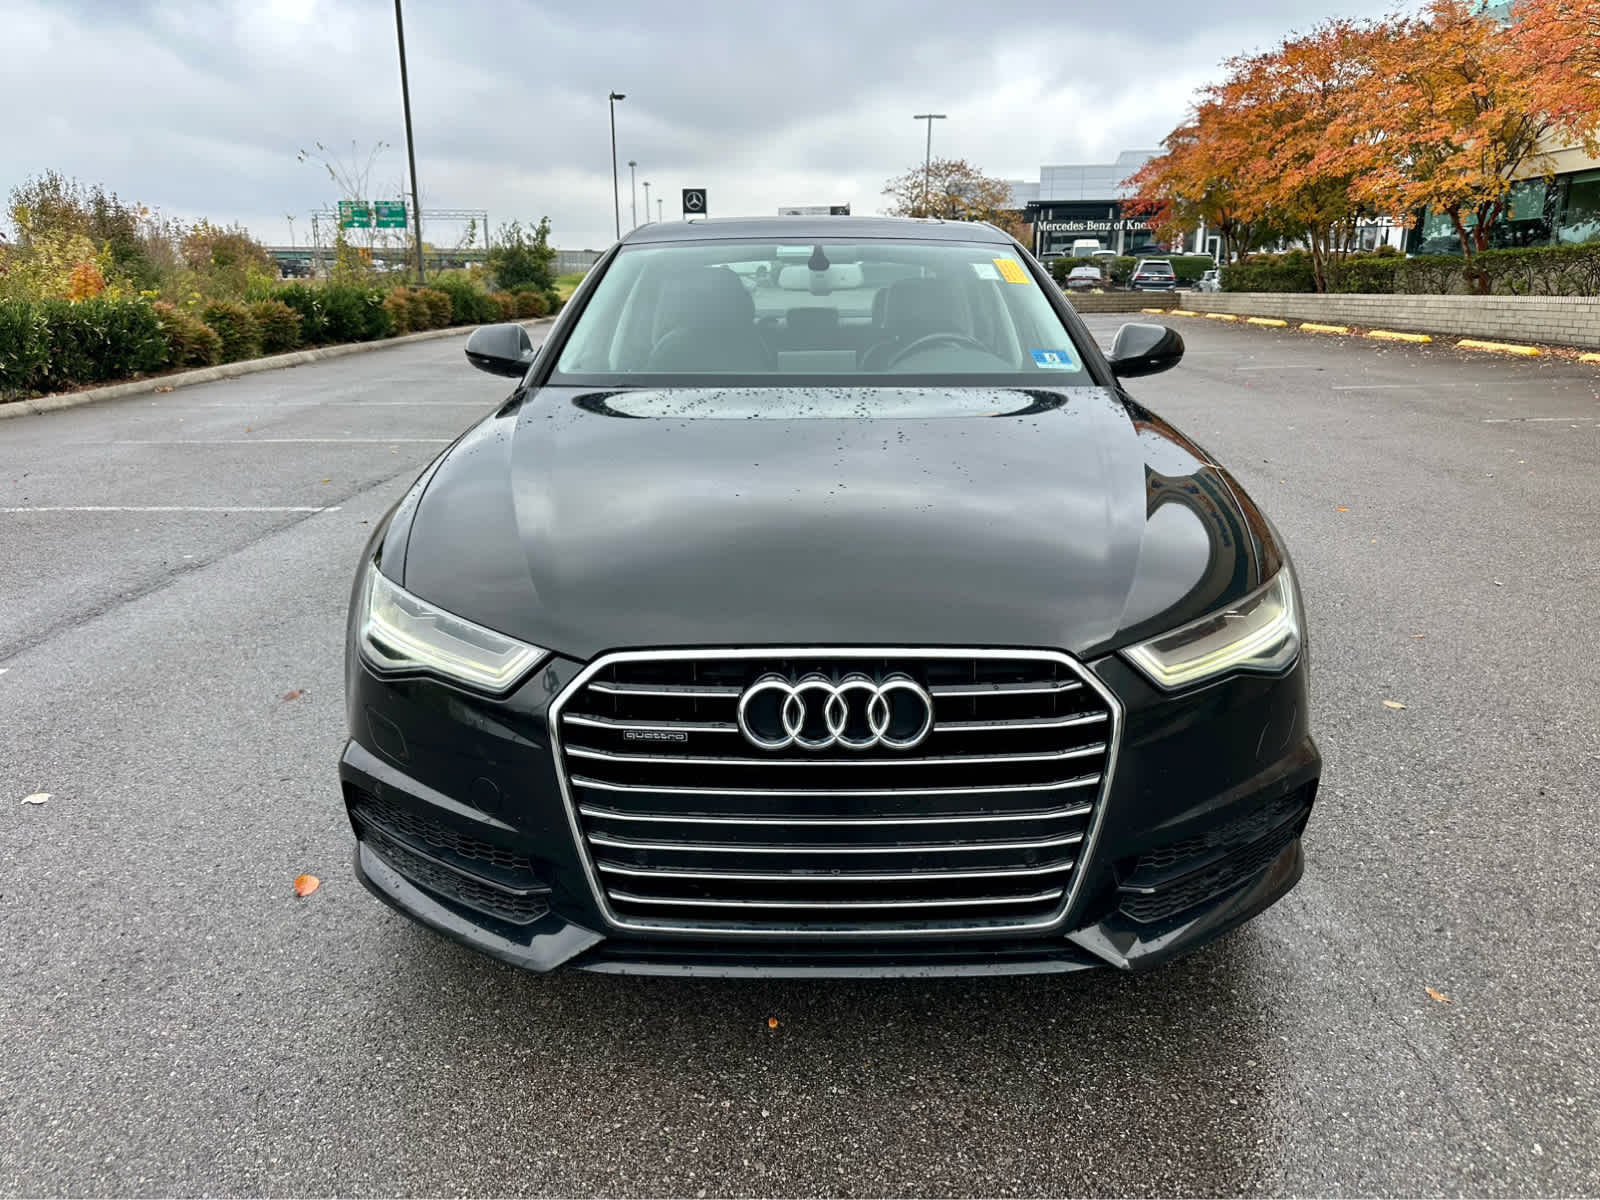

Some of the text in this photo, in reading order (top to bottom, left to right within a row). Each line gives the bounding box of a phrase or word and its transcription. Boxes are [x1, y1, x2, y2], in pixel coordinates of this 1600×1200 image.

[1037, 220, 1111, 231] Mercedes-Benz
[1113, 219, 1125, 231] of
[625, 731, 686, 741] quattro
